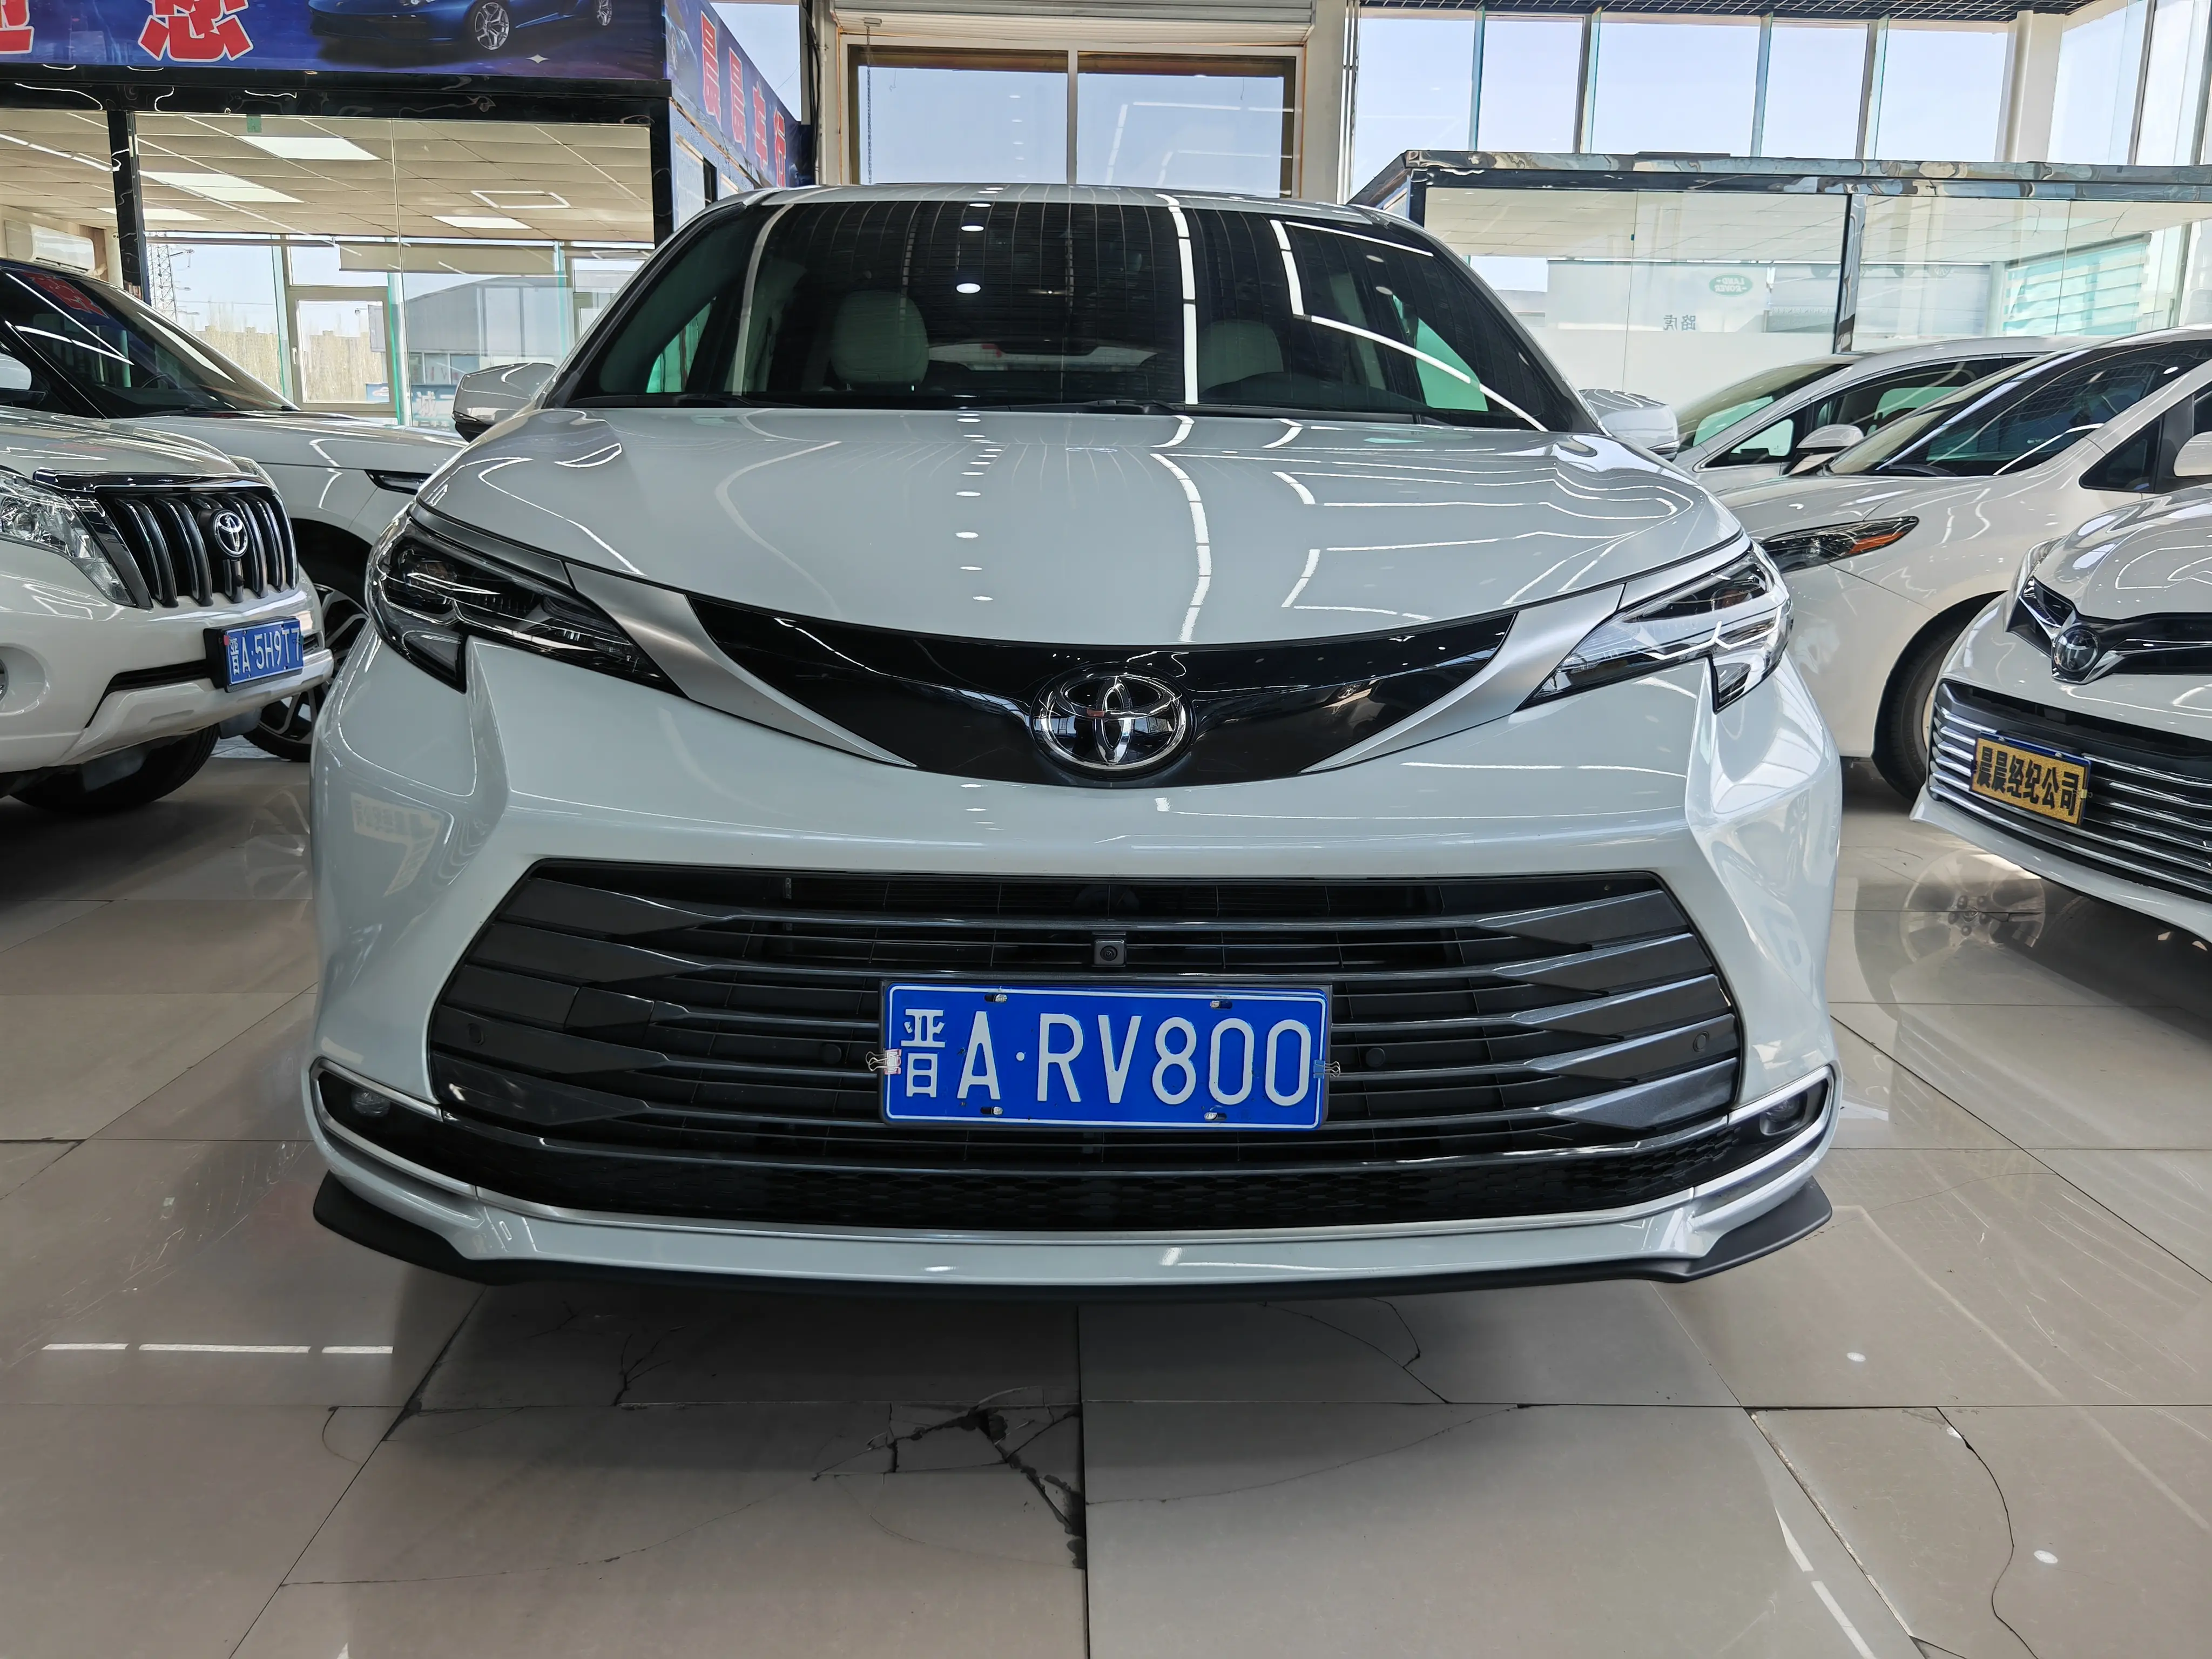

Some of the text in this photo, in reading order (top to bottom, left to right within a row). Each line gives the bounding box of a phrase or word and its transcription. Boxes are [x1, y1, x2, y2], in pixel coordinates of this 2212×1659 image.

[1976, 746, 2080, 816] 晨晨经纪公司
[900, 1008, 1312, 1107] 晋A·RV800
